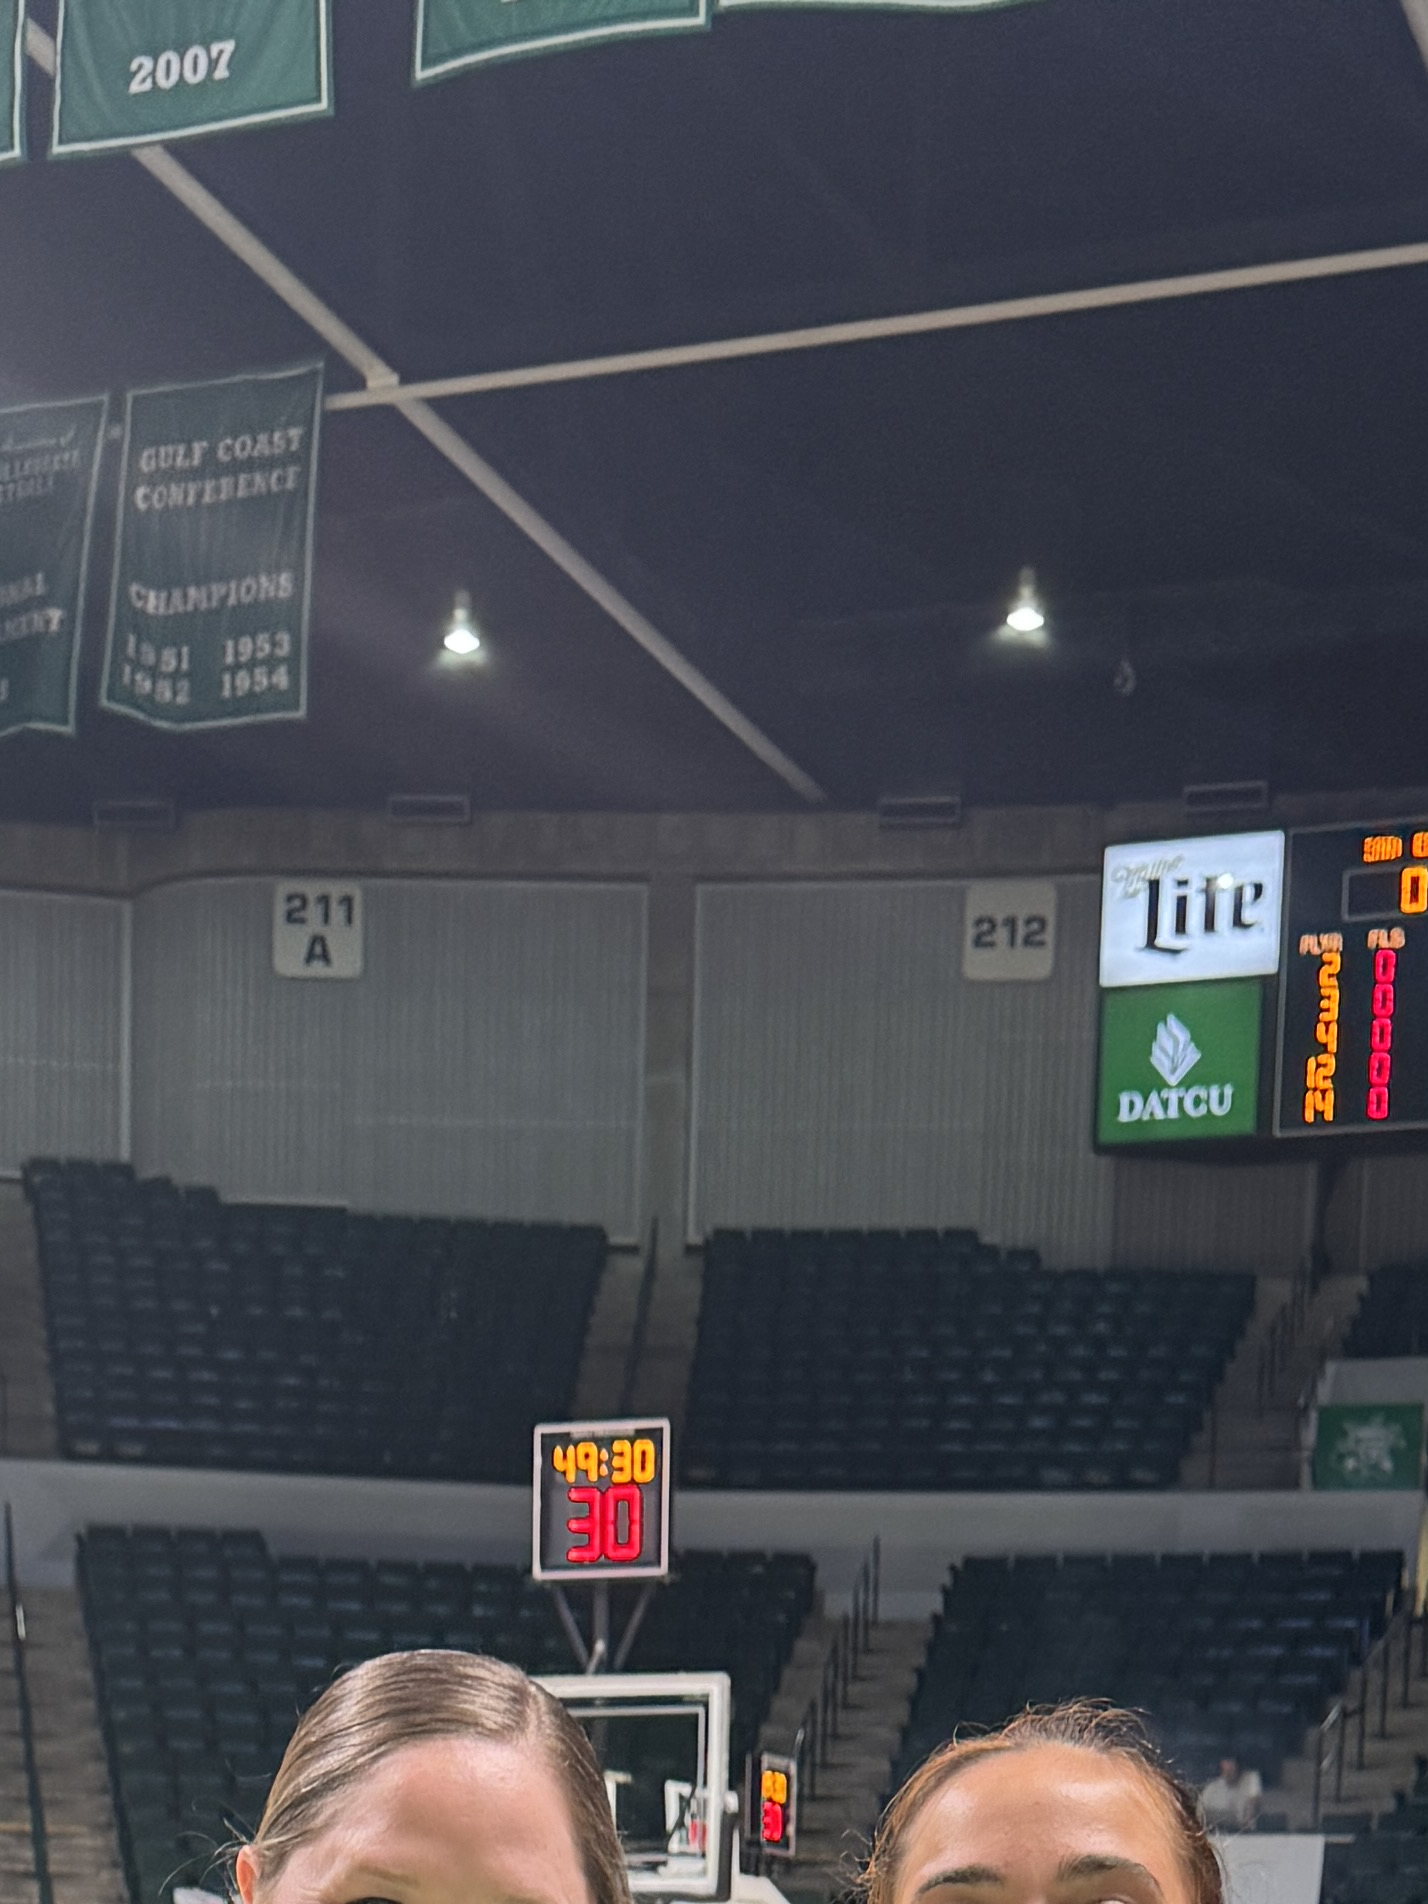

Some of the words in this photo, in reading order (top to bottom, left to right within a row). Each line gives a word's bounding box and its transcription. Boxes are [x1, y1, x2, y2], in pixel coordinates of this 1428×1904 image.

[129, 40, 235, 95] 2007
[139, 440, 209, 473] GULF
[217, 427, 303, 462] COAST
[134, 466, 301, 510] CONFERENCE
[129, 571, 294, 617] CHAMPIONS
[222, 631, 292, 667] 1953
[221, 664, 289, 699] 1954
[285, 892, 355, 927] 211
[1399, 866, 1428, 915] 0
[973, 914, 1048, 950] 212
[1135, 874, 1265, 954] Lite
[304, 934, 333, 967] A
[1319, 951, 1341, 987] 2
[1375, 949, 1396, 984] 0
[1319, 987, 1339, 1021] 3
[1373, 983, 1394, 1017] 0
[1316, 1021, 1337, 1053] 4
[1371, 1018, 1392, 1052] 0
[1306, 1053, 1336, 1090] 12
[1369, 1052, 1391, 1086] 0
[1117, 1083, 1234, 1122] DATCU
[1303, 1089, 1334, 1123] 14
[1366, 1086, 1389, 1119] 0
[552, 1438, 655, 1484] 49:30
[566, 1485, 644, 1562] 30
